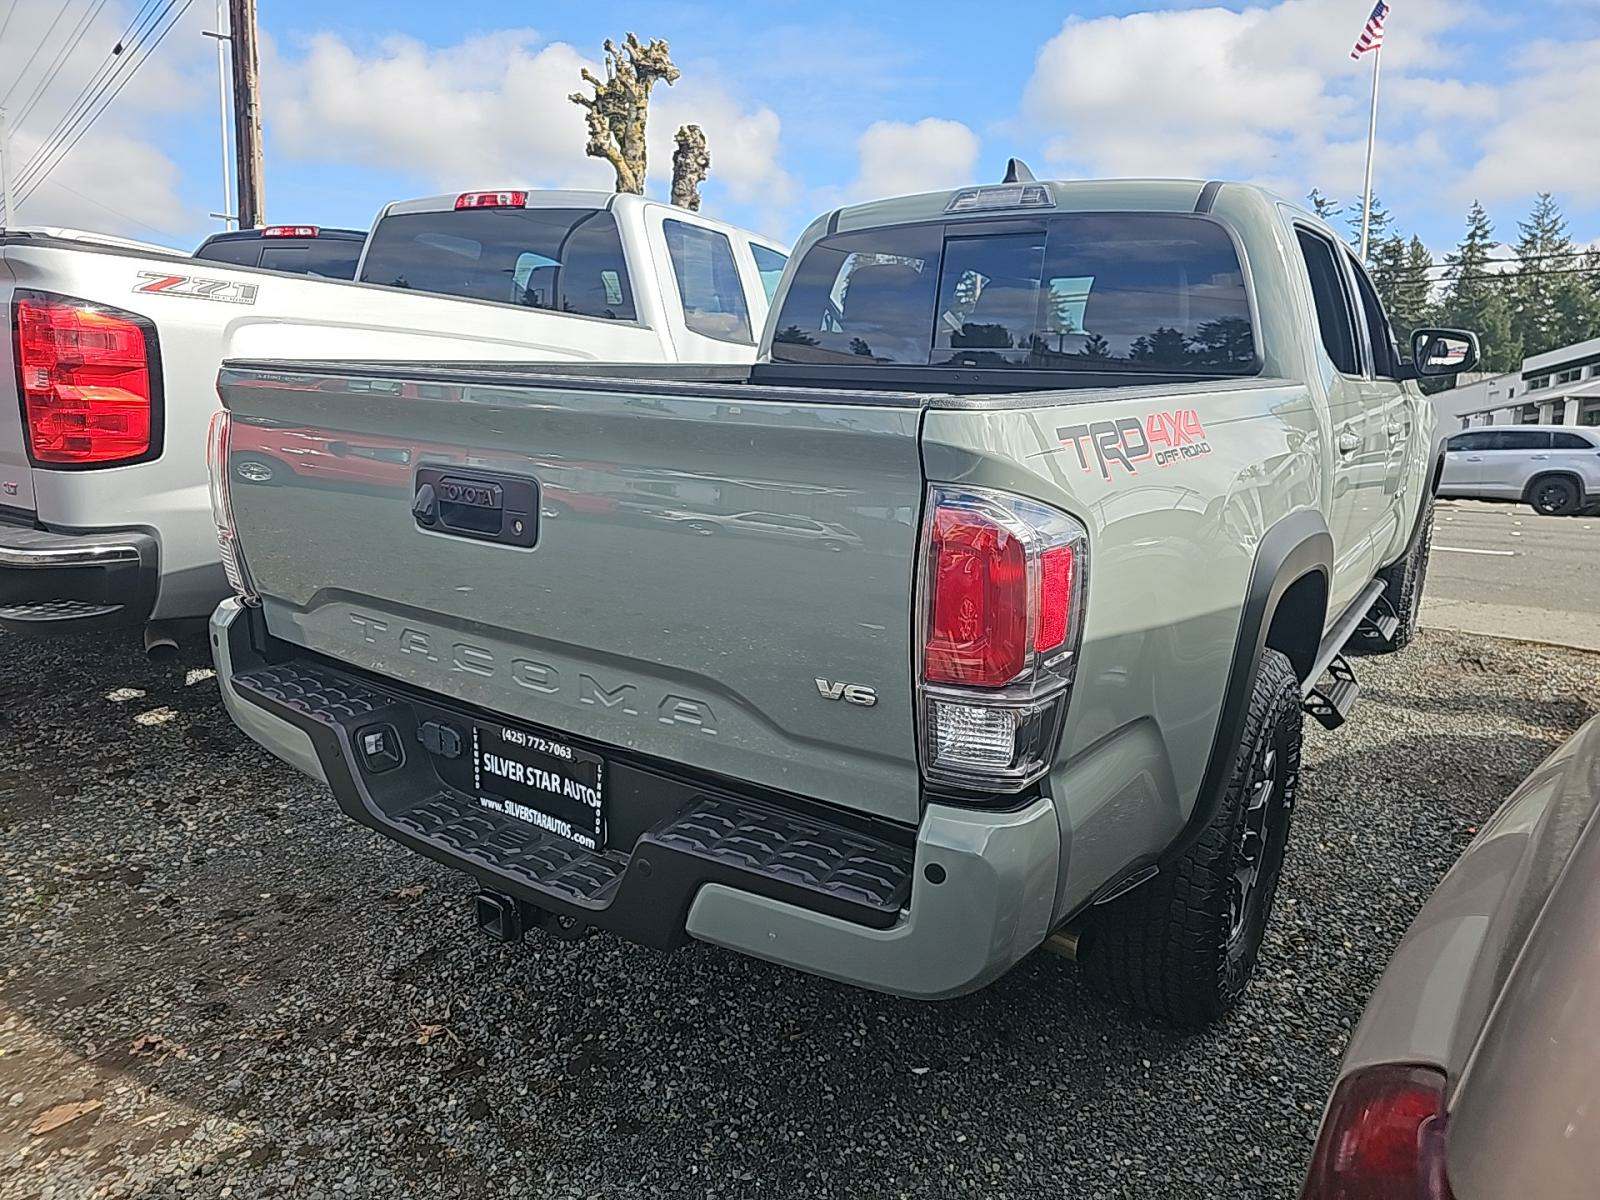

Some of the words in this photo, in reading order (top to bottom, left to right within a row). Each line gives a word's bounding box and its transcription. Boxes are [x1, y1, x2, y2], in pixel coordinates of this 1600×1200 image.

[1056, 417, 1150, 480] TRD
[1155, 448, 1180, 466] OFF
[1181, 441, 1213, 460] ROAD
[440, 481, 495, 507] TOYOTA
[349, 612, 718, 735] TACOMA
[814, 677, 877, 707] V6
[501, 727, 527, 746] (425)
[527, 735, 572, 759] 772-7063
[483, 752, 525, 784] SILVER
[526, 767, 561, 794] STAR
[563, 778, 597, 808] AUTO
